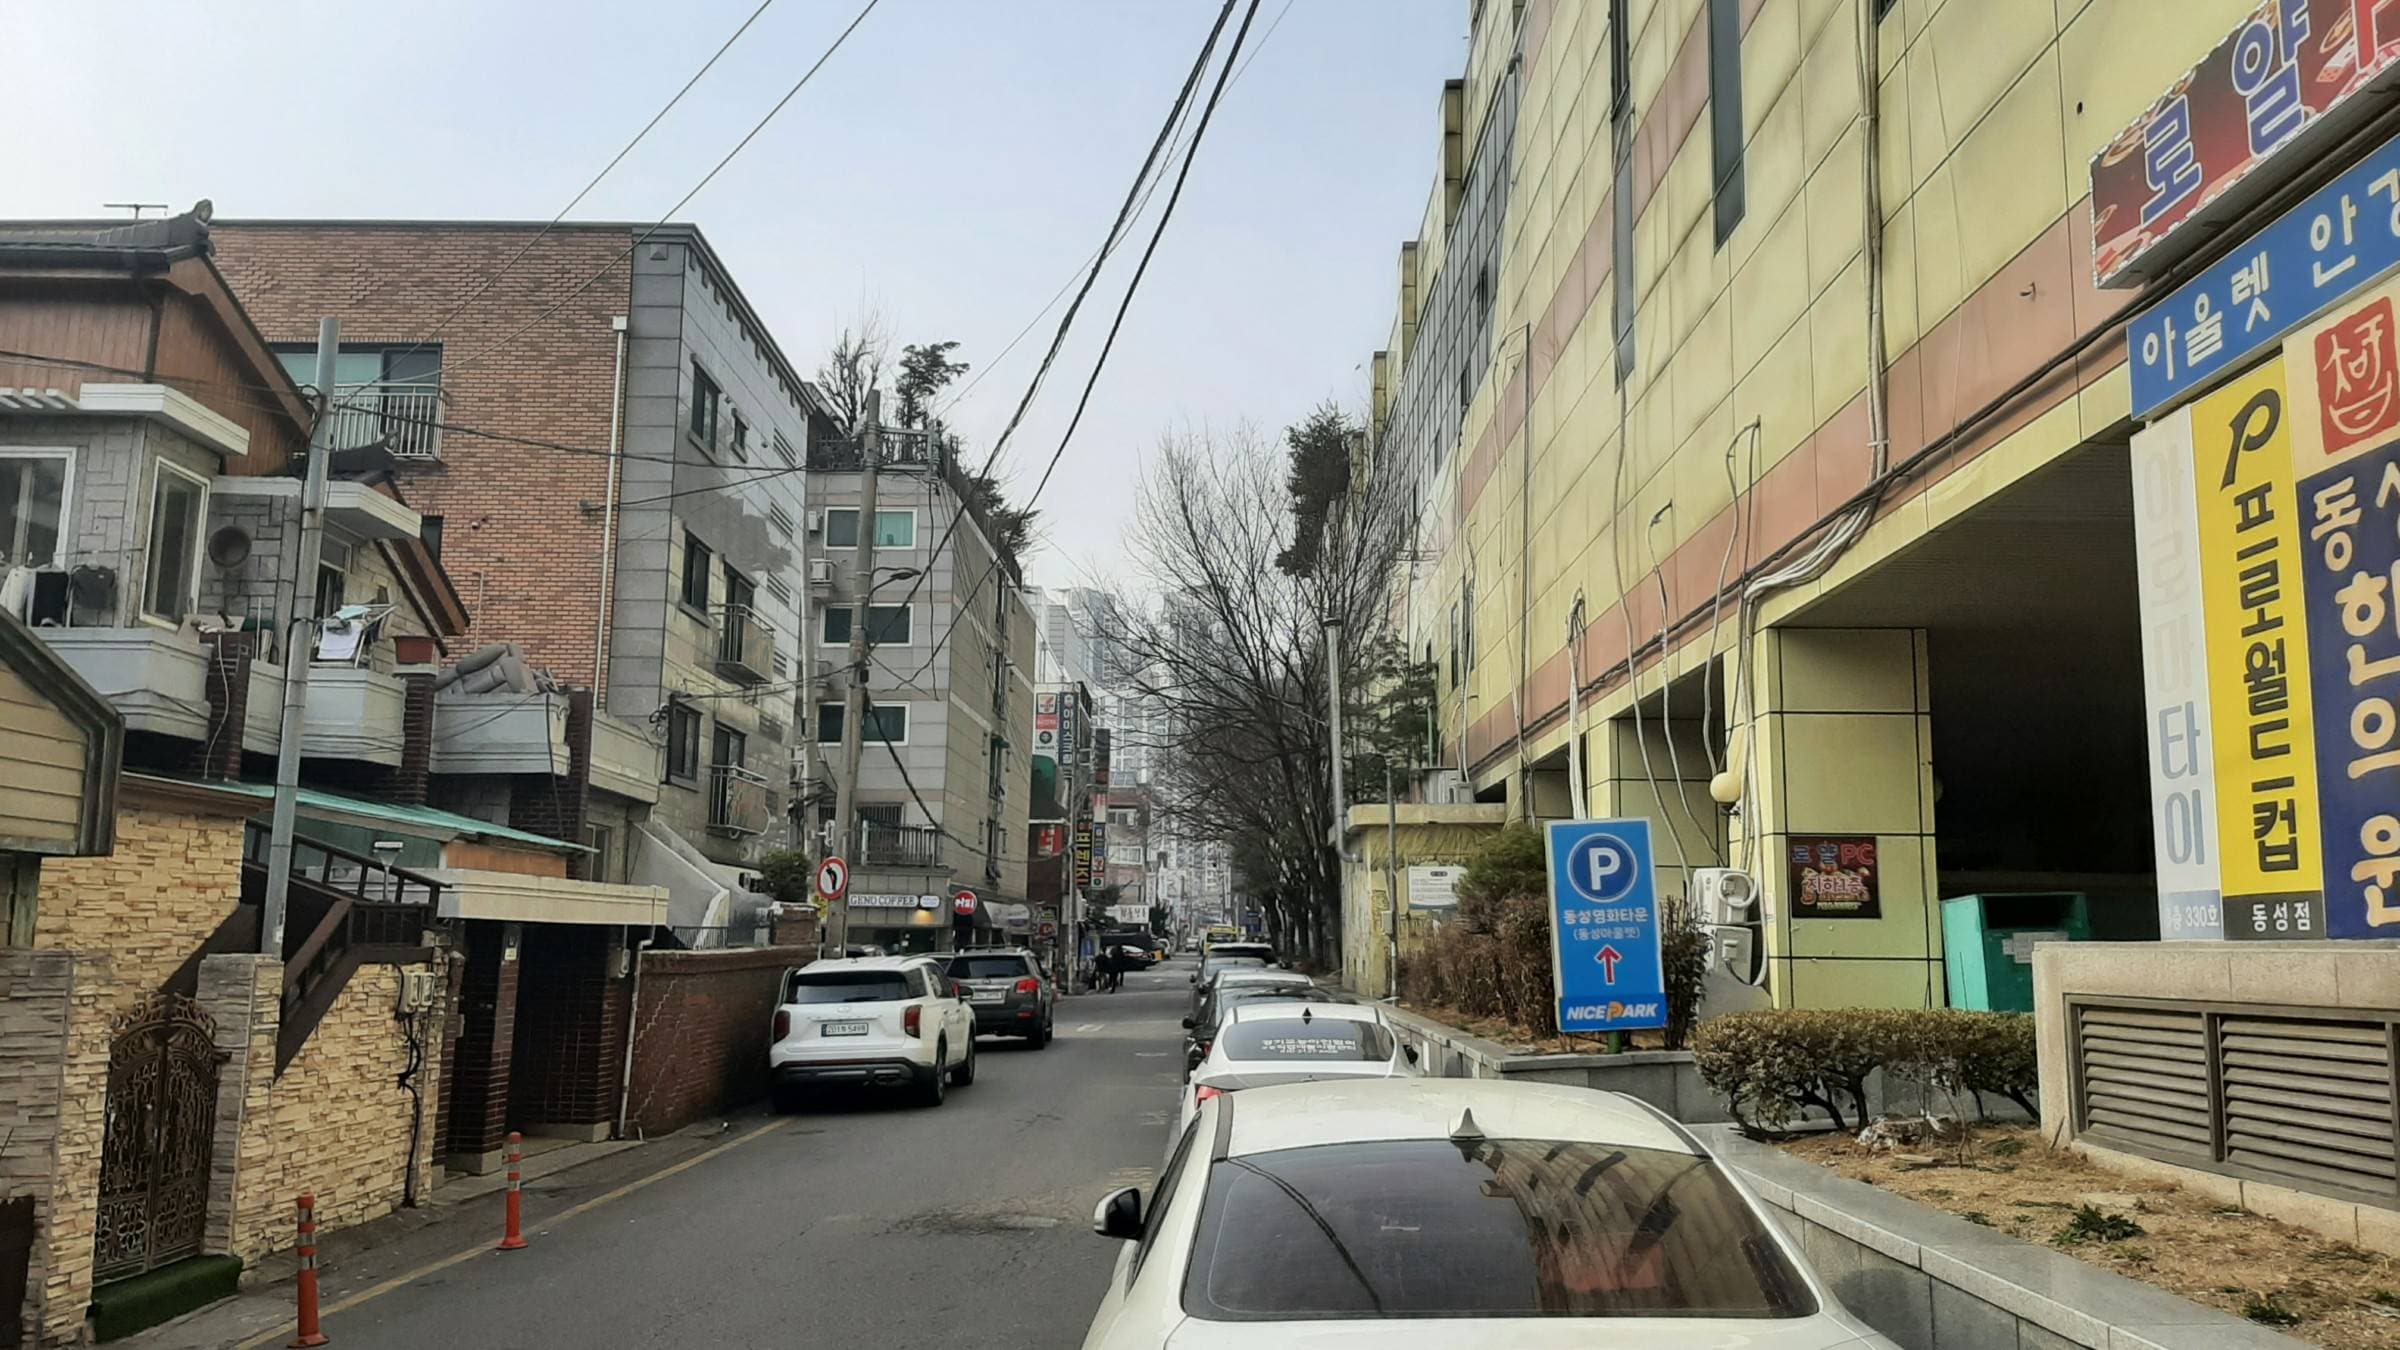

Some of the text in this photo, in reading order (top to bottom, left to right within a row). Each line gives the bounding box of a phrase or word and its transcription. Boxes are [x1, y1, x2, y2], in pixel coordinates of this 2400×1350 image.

[2142, 251, 2271, 381] 아울렛
[2233, 482, 2299, 874] 프로월드컵
[1841, 844, 1874, 865] PC
[1588, 847, 1621, 891] P
[1563, 907, 1648, 925] 동성영화타운
[2185, 904, 2219, 927] 330호
[2251, 901, 2311, 932] 동성점
[1567, 1002, 1658, 1022] NICEPARK
